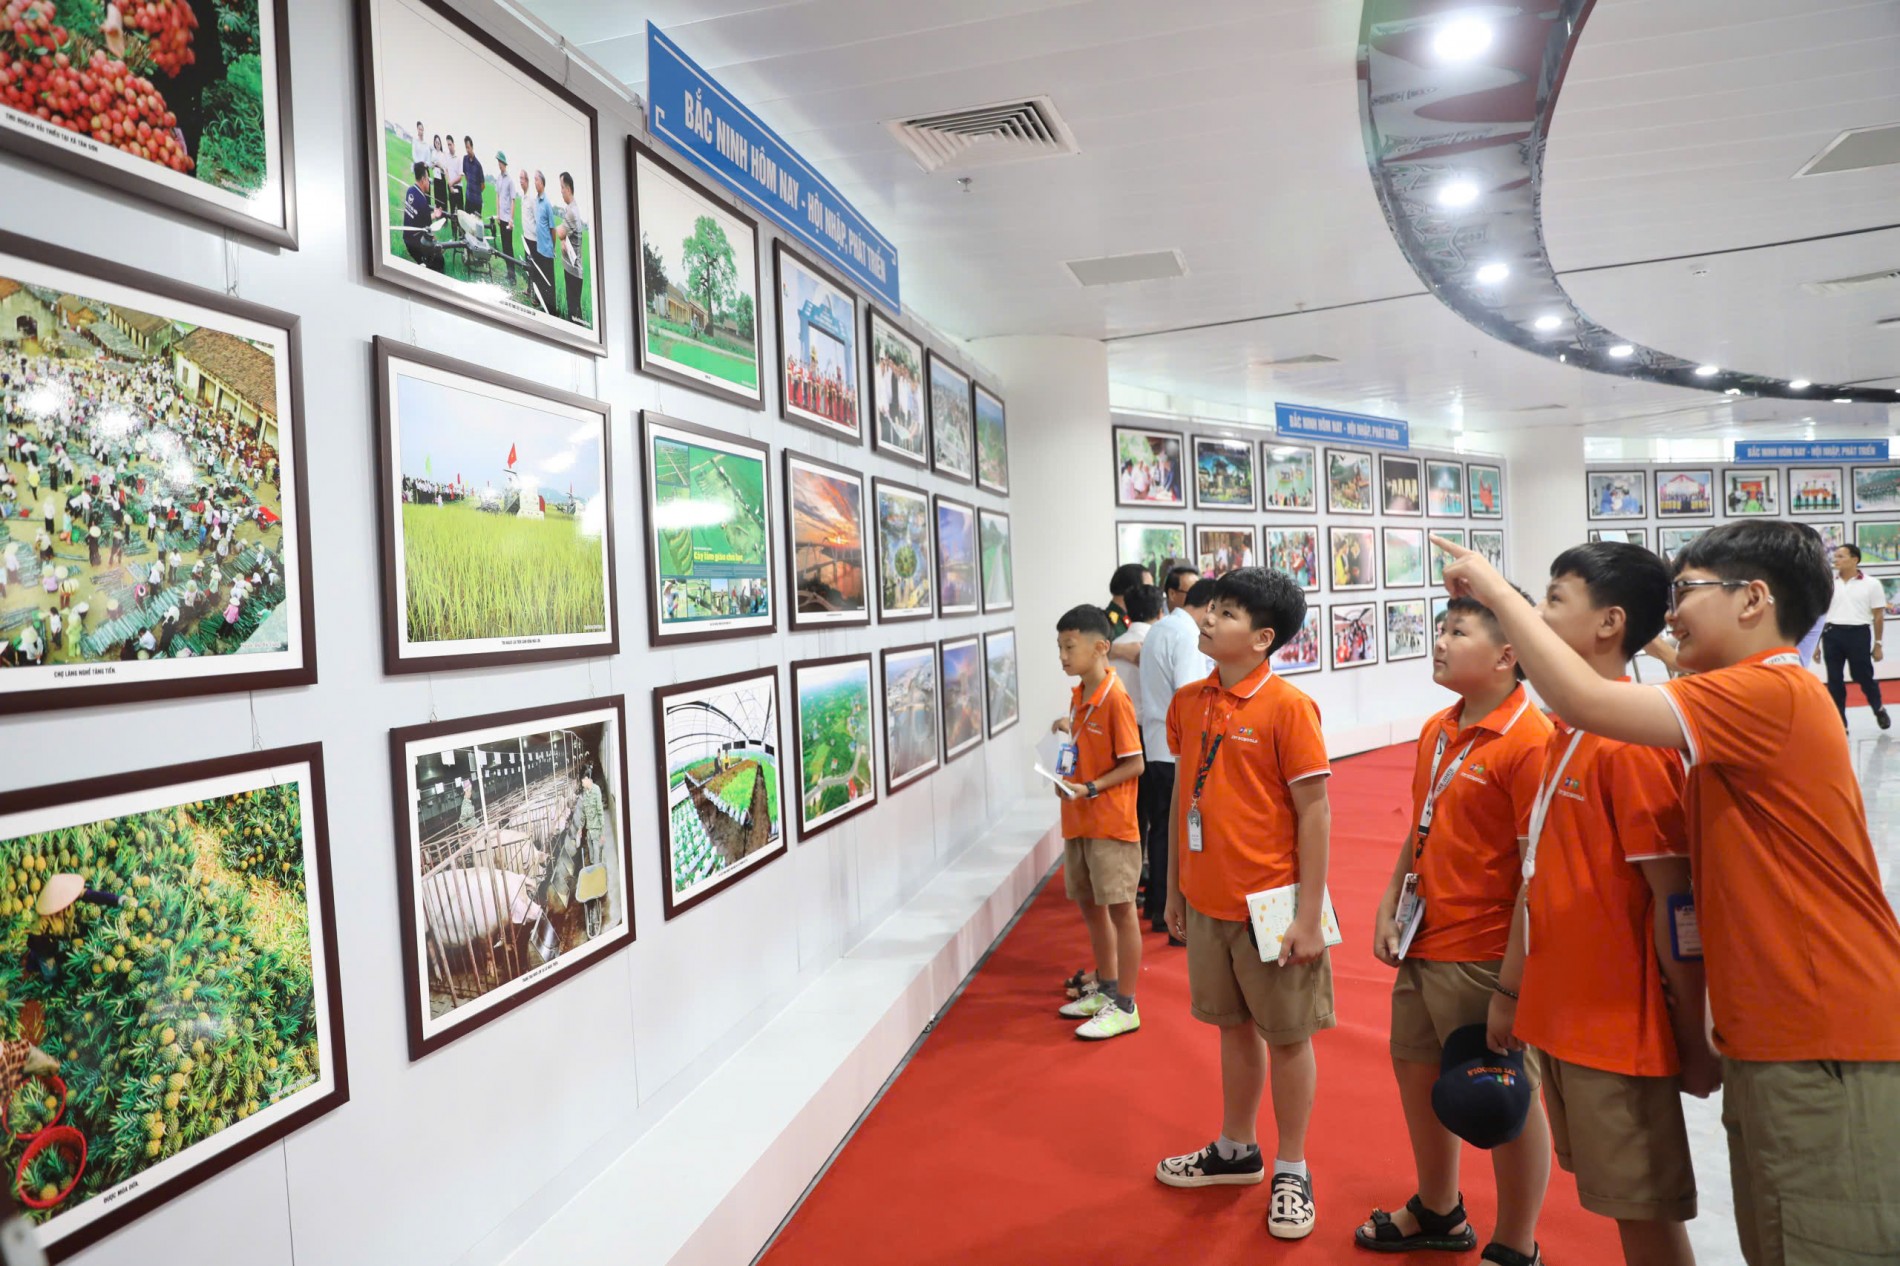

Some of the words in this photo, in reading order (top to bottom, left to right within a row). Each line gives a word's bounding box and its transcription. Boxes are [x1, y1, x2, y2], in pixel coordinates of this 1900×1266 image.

[684, 88, 713, 145] BẮC
[716, 116, 748, 173] NINH
[751, 143, 777, 195] HÔM
[779, 168, 800, 211] NAY
[807, 192, 823, 234] HỘI
